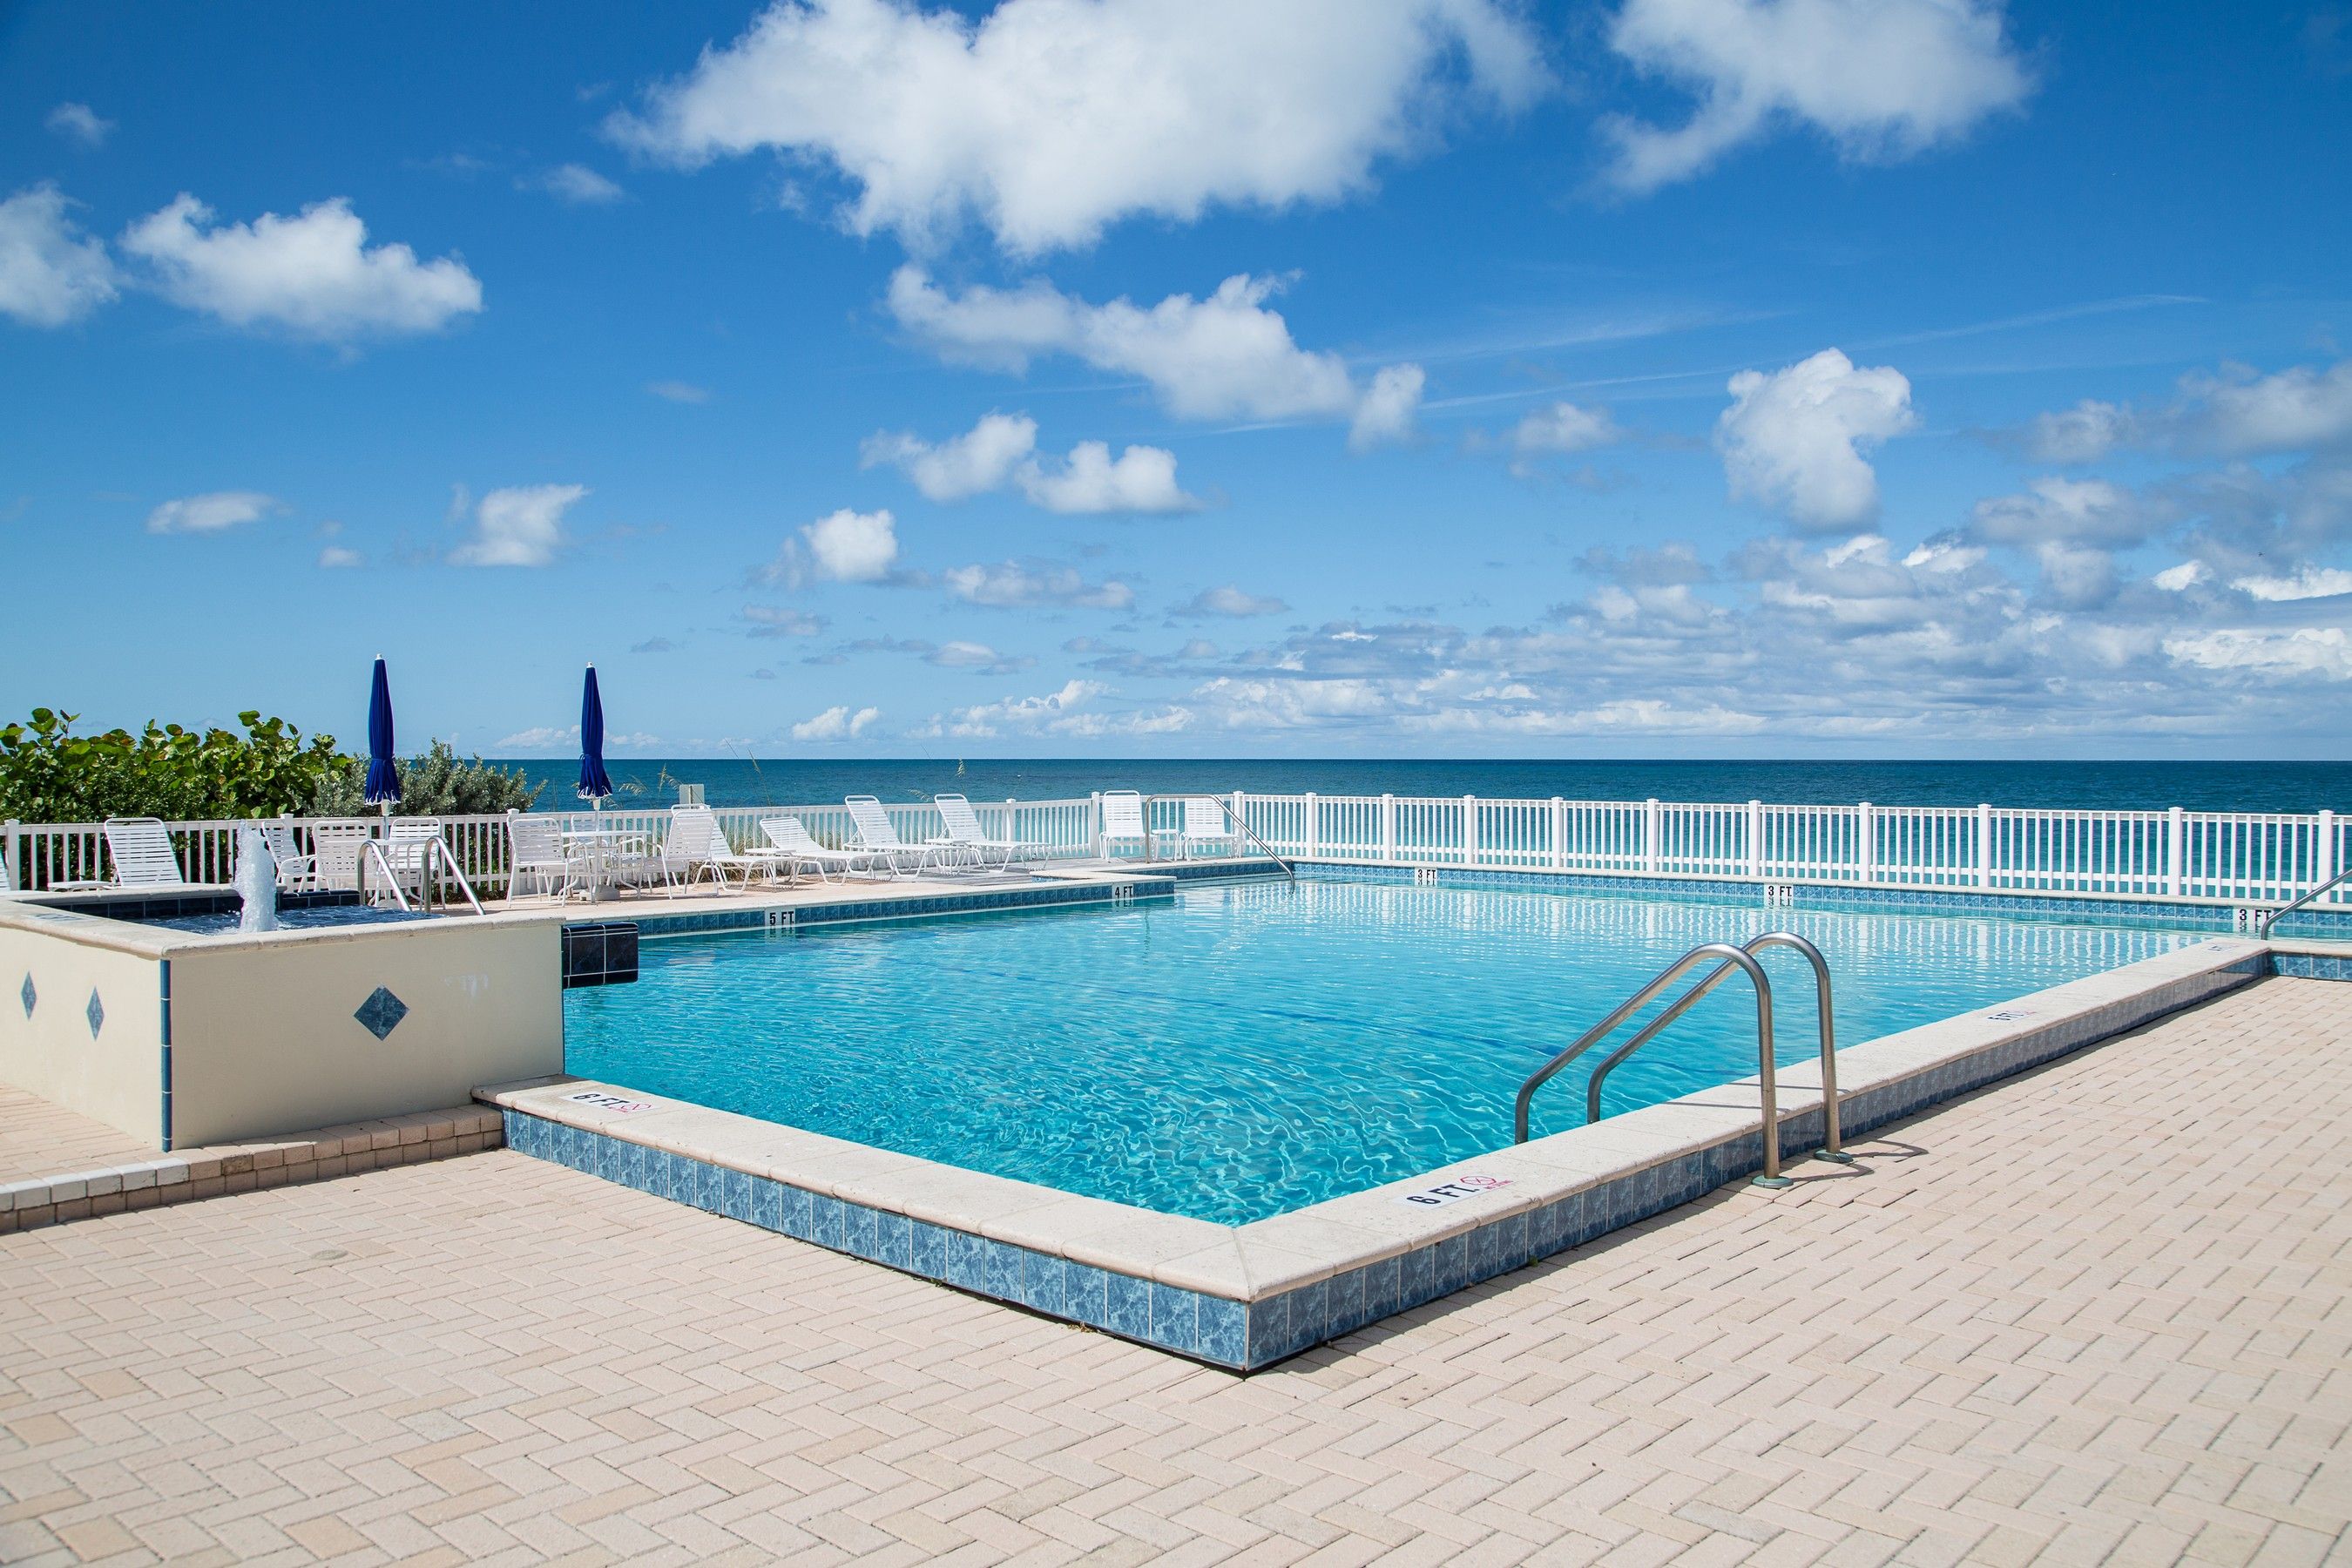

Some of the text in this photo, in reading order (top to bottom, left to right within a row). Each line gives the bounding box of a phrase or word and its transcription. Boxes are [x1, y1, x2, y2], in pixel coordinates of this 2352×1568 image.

[1417, 868, 1423, 879] 3
[1115, 886, 1120, 898] 4
[1768, 885, 1792, 897] 3 FT.
[769, 911, 794, 926] 5 FT.
[2239, 909, 2247, 921] 3
[1406, 1195, 1442, 1205] 6
[1427, 1183, 1480, 1199] FT.
